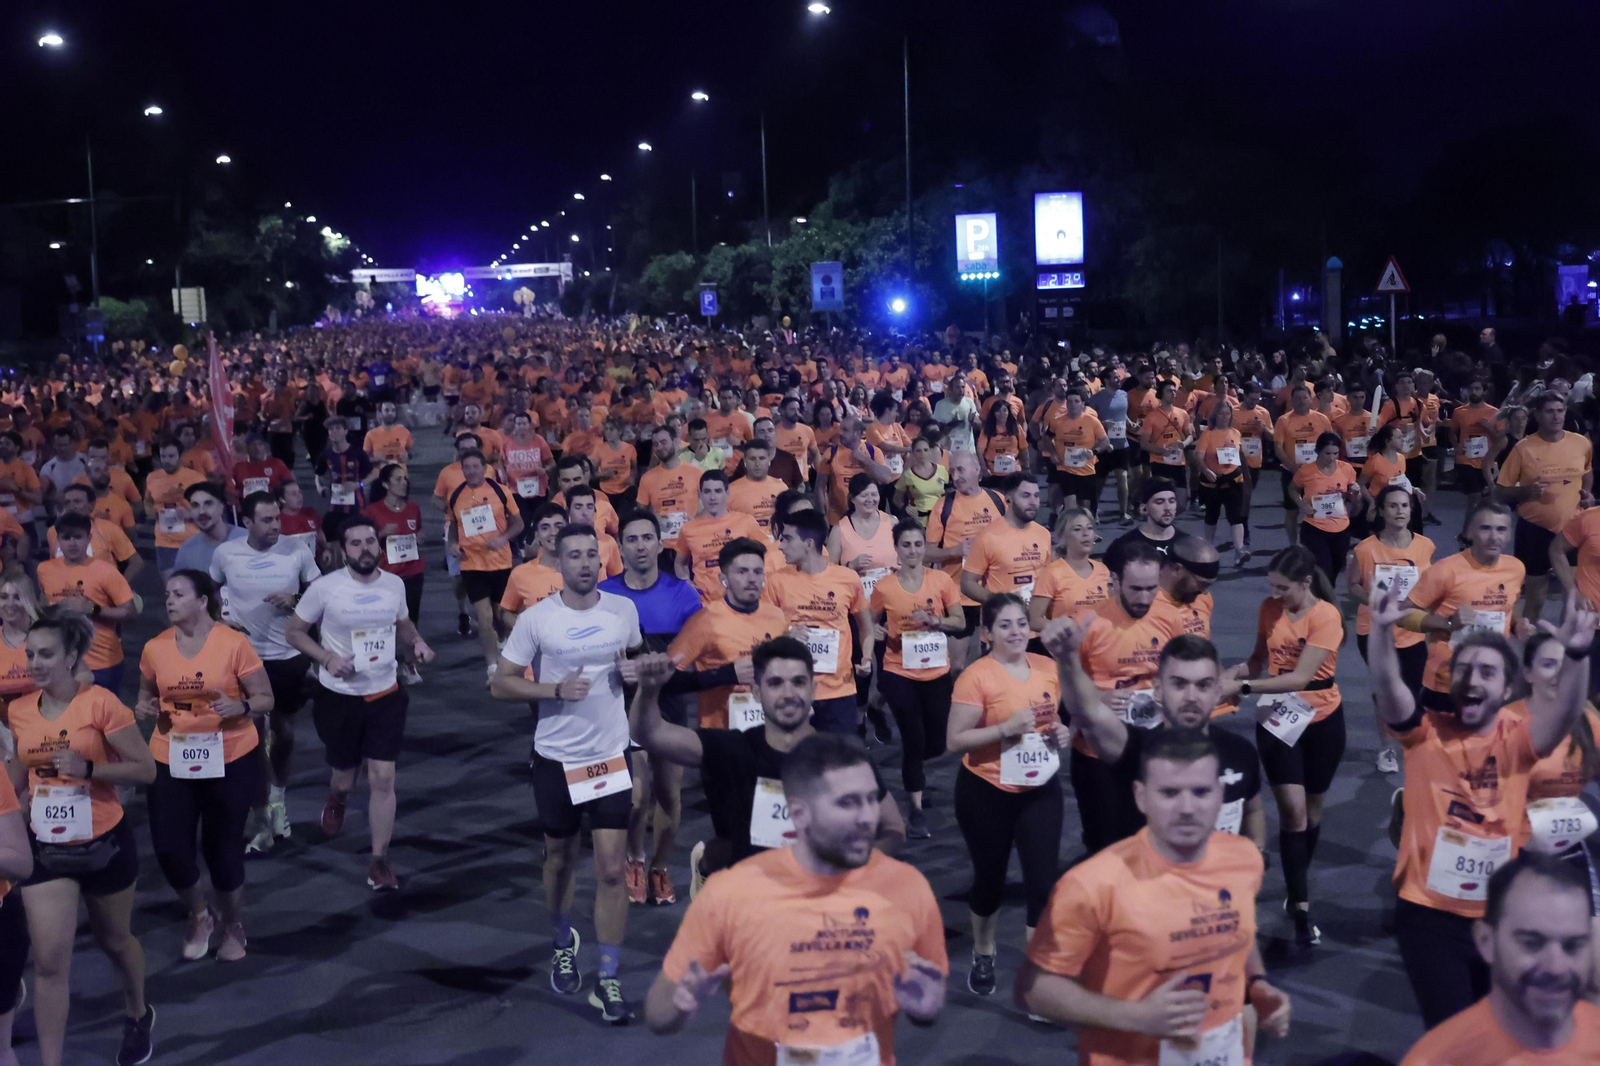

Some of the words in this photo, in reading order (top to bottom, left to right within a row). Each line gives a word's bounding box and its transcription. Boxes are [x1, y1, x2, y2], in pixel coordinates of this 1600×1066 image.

[704, 294, 713, 305] P
[508, 448, 540, 464] MORE
[1388, 578, 1408, 586] 796
[364, 640, 386, 652] 7742
[556, 646, 580, 656] Qualis
[914, 642, 940, 654] 13035
[182, 748, 210, 760] 6079
[1016, 750, 1050, 764] 10414
[586, 762, 610, 778] 829
[46, 805, 76, 820] 6251
[1551, 818, 1582, 834] 3783
[1456, 856, 1494, 876] 8310
[1169, 926, 1214, 942] SEVILLA
[790, 941, 842, 954] SEVILLA
